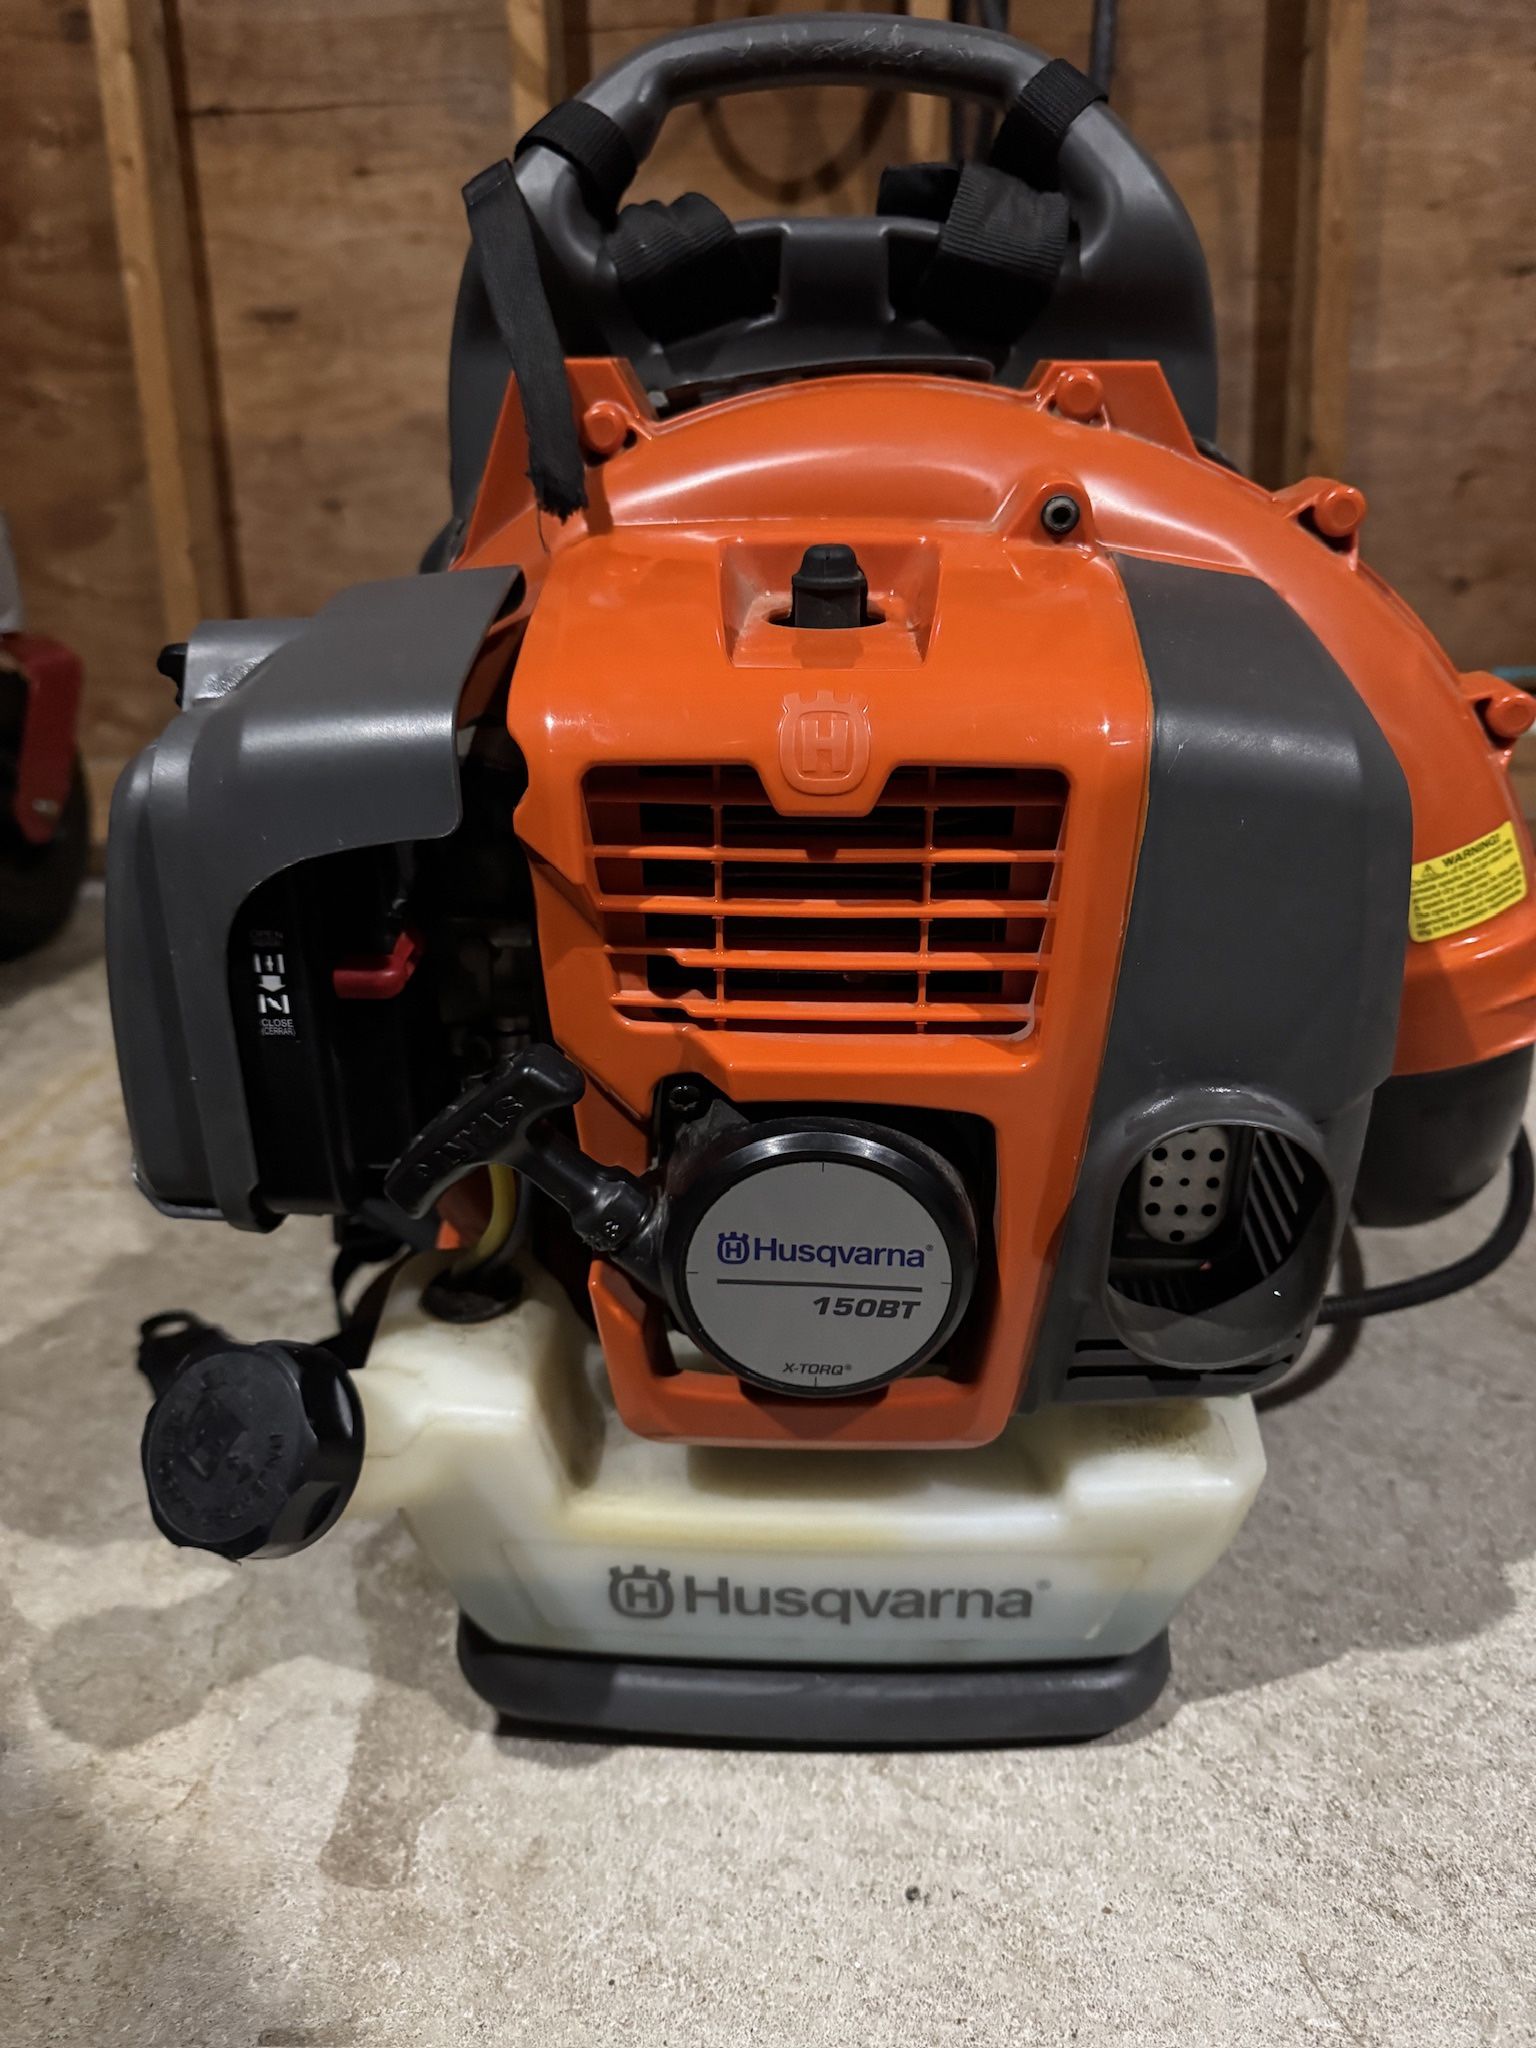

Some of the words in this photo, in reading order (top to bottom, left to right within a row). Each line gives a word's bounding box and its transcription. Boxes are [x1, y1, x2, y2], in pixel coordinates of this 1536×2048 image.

[1442, 833, 1500, 867] WARNING!
[261, 1018, 294, 1028] CLOSE
[813, 1296, 921, 1319] 150BT
